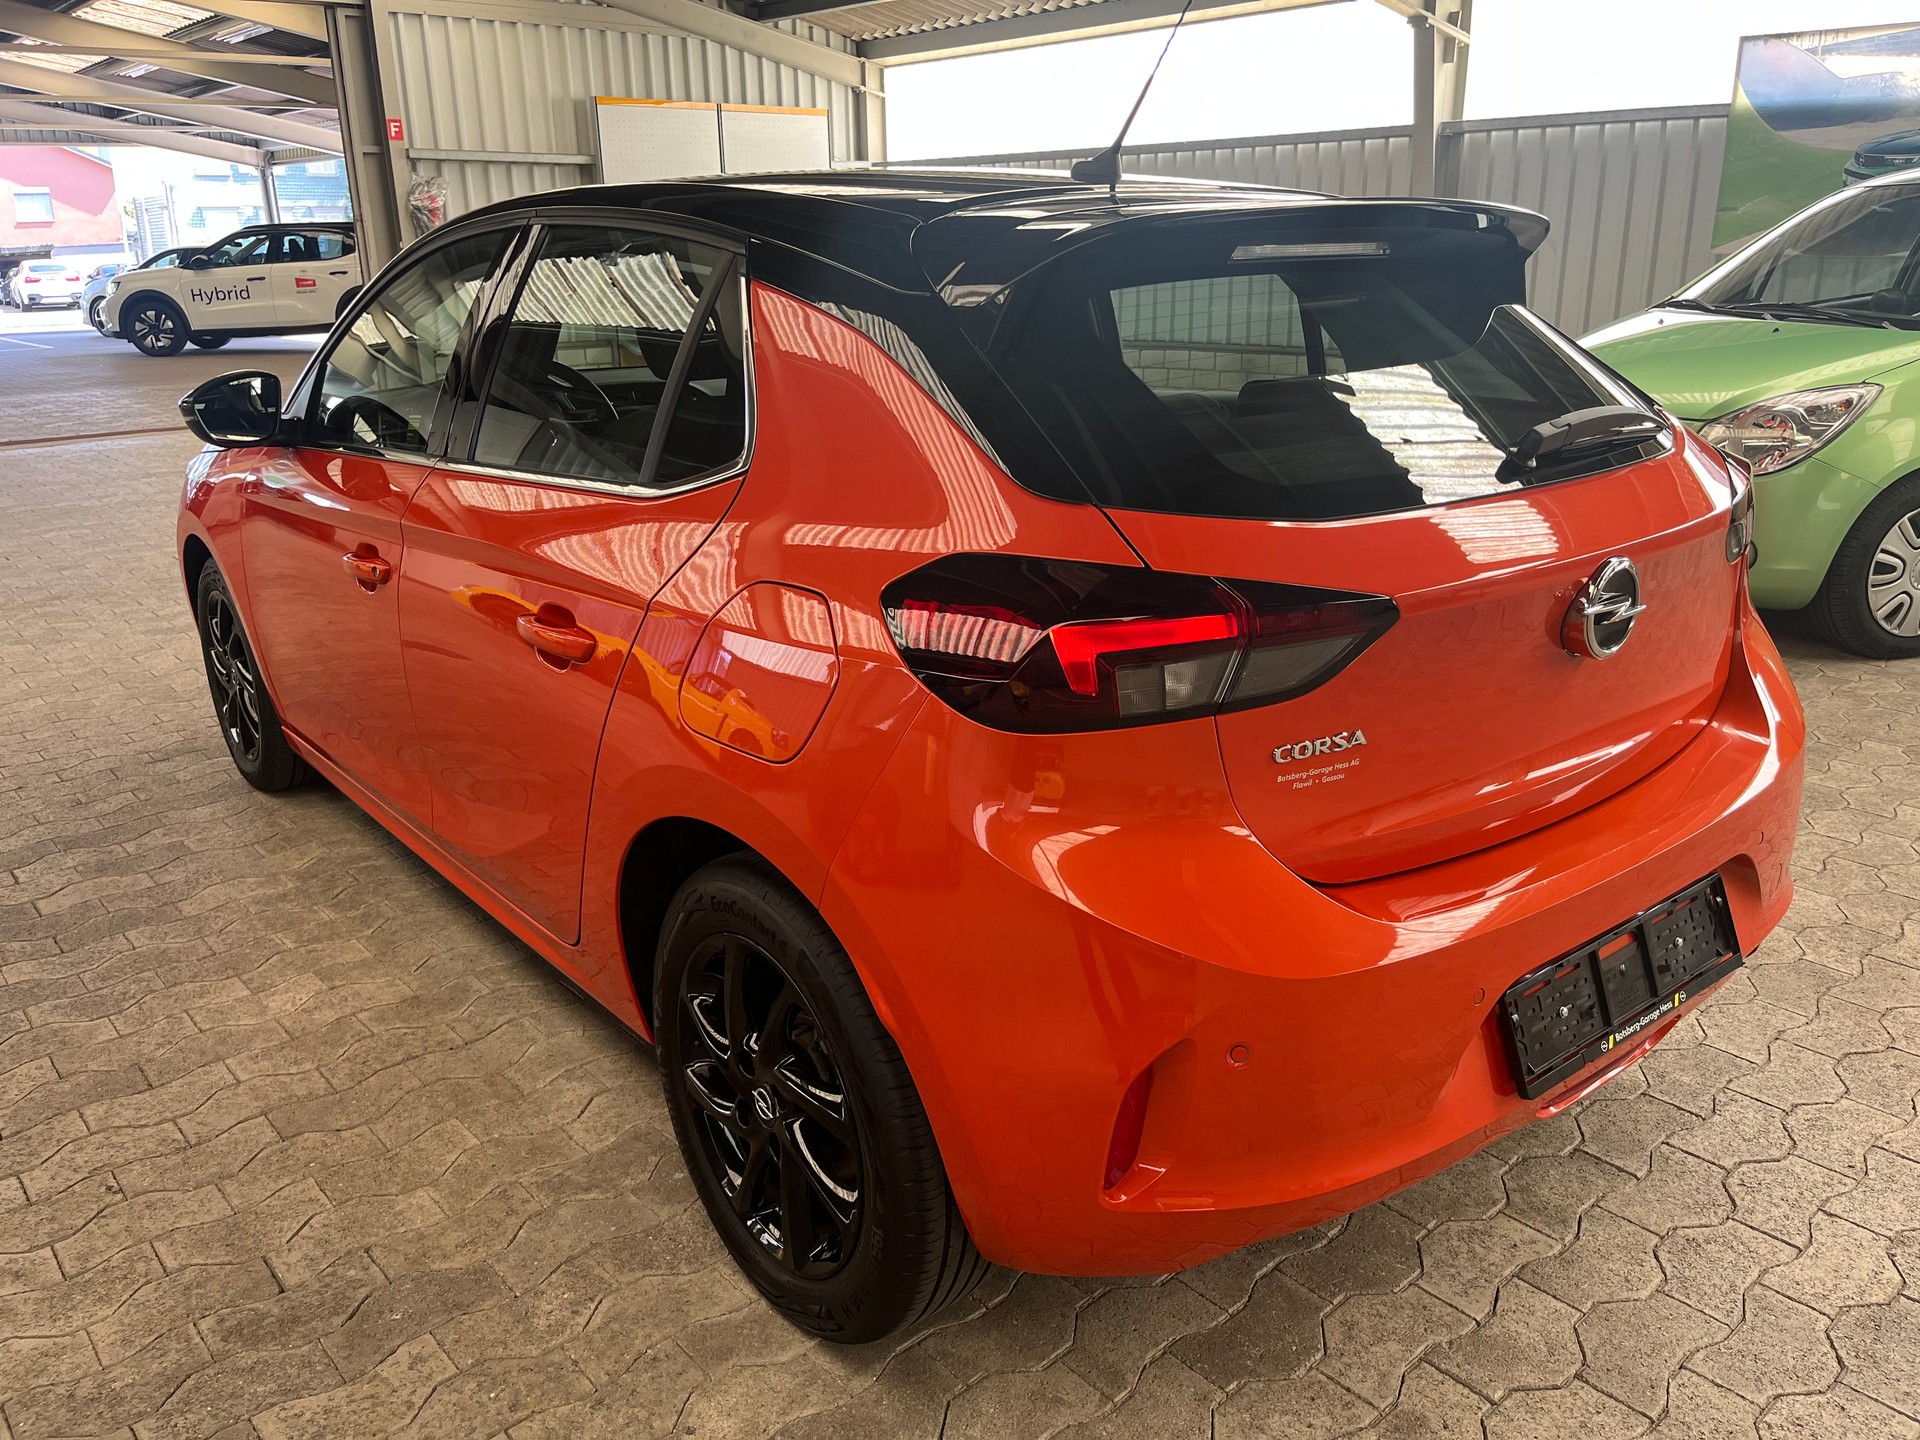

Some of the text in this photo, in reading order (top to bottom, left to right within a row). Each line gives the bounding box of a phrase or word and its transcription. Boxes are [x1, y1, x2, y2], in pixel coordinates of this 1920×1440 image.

[390, 122, 401, 137] F
[190, 285, 251, 305] Hybrid
[1271, 729, 1368, 764] CORSA
[1277, 758, 1360, 782] Botsberg-Garage Hess AG
[1292, 773, 1345, 789] Flawil Gossau
[710, 895, 777, 945] EcoContact
[1615, 1001, 1673, 1042] Botsberg-Garage Hess
